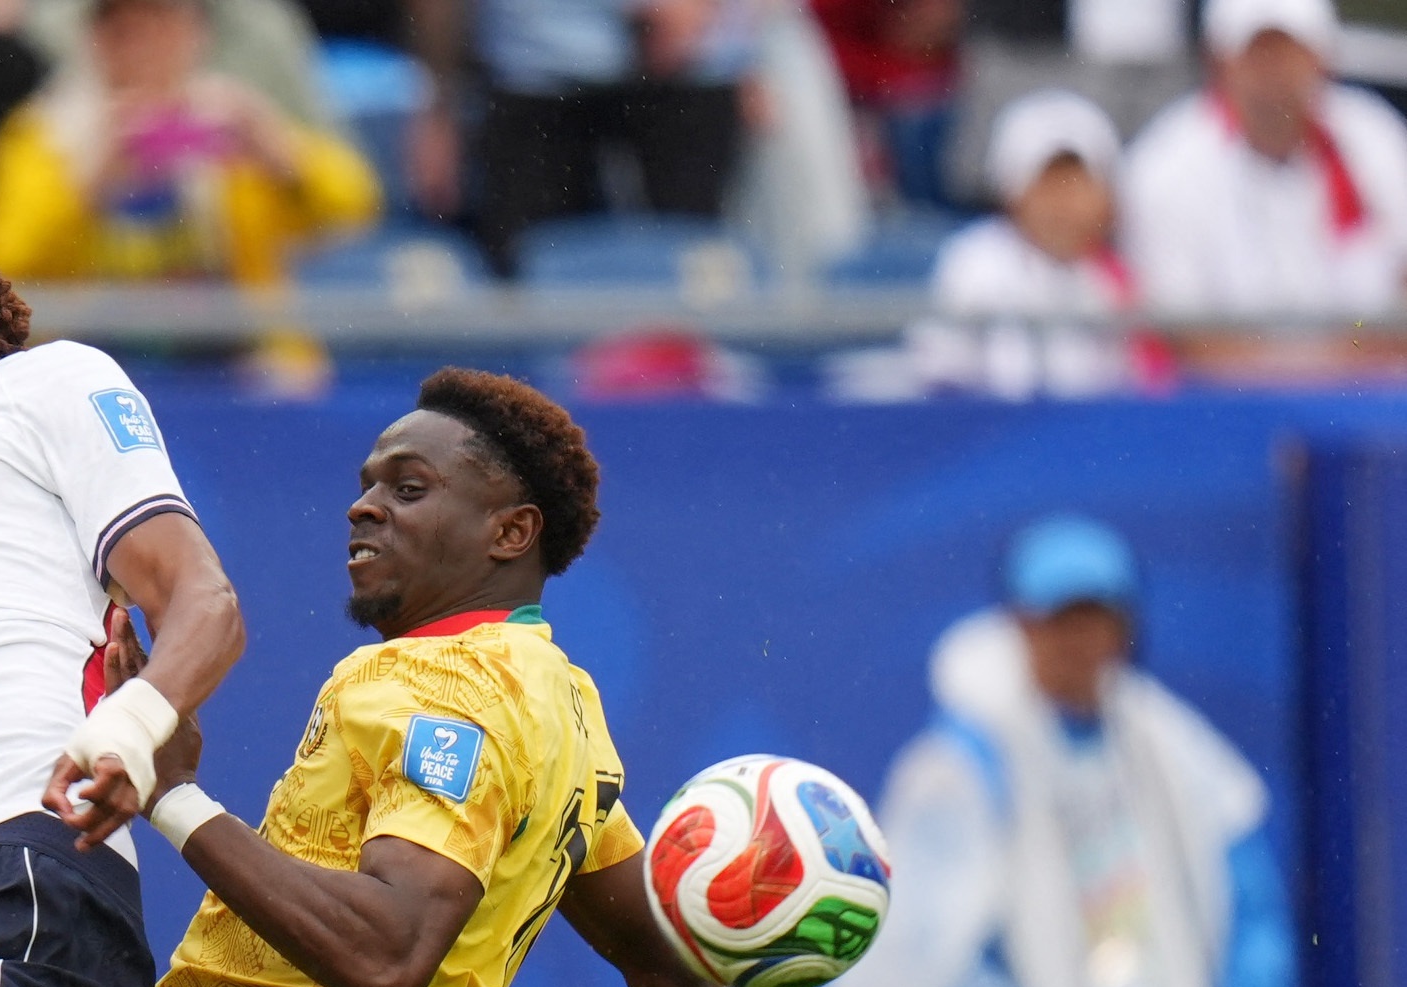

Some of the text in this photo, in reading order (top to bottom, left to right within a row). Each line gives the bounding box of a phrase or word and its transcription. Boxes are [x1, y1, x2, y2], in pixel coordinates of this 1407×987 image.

[420, 746, 460, 767] Unite For
[419, 759, 455, 781] PEACE
[424, 776, 444, 787] FIFA
